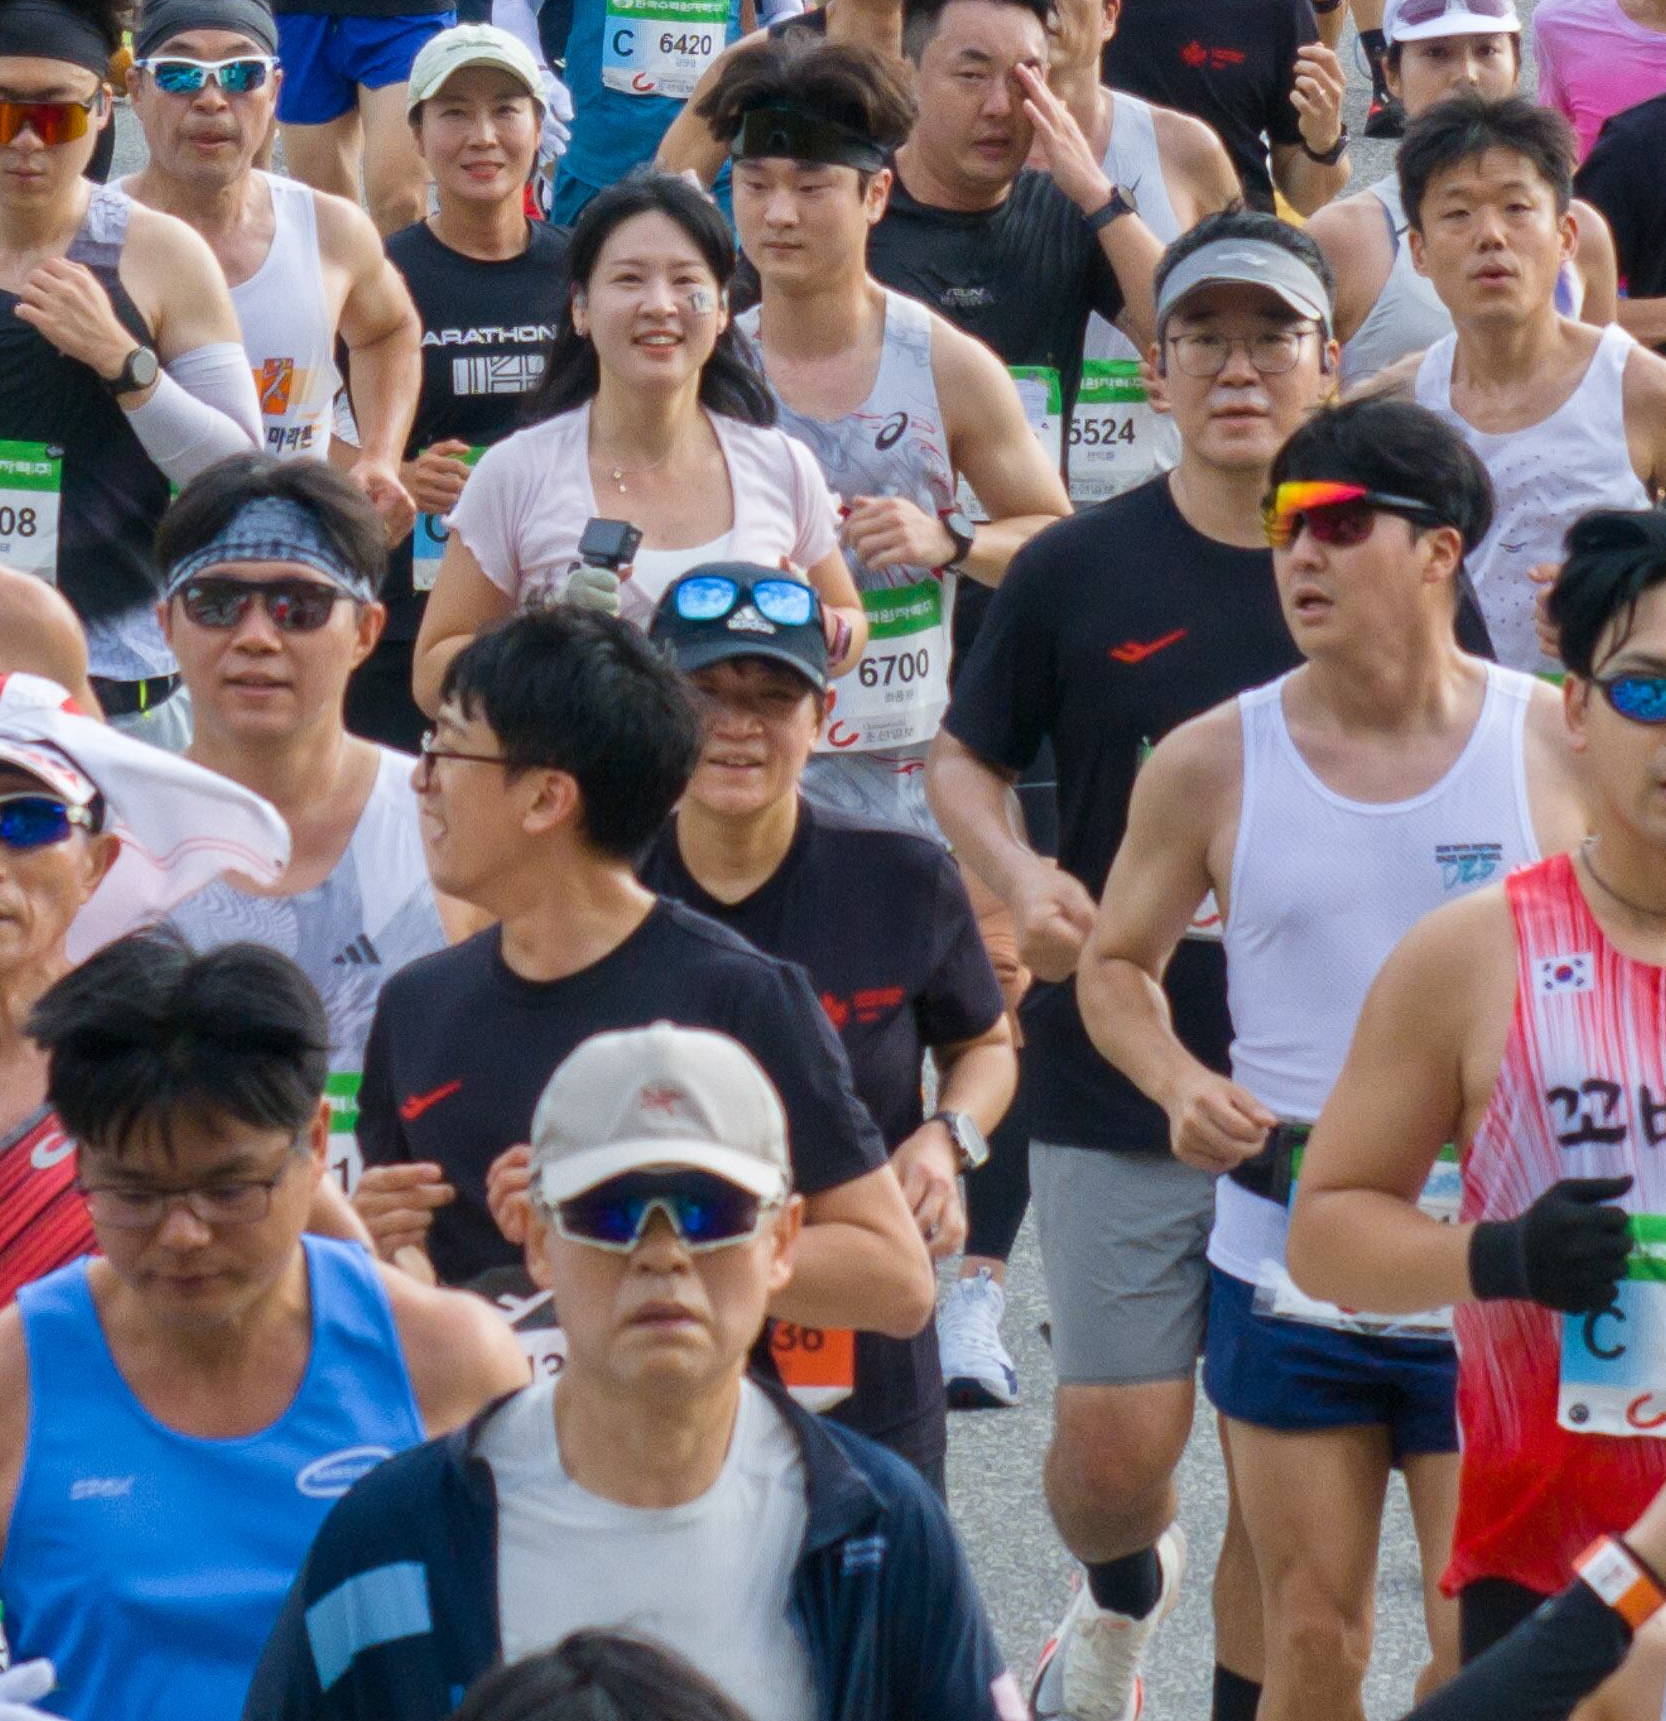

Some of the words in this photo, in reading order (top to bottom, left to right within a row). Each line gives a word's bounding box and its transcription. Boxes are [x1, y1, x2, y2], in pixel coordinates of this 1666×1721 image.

[612, 30, 633, 57] C
[659, 33, 713, 57] 6420
[421, 324, 558, 347] ARATHON
[859, 646, 930, 689] 6700
[1583, 1306, 1627, 1360] C
